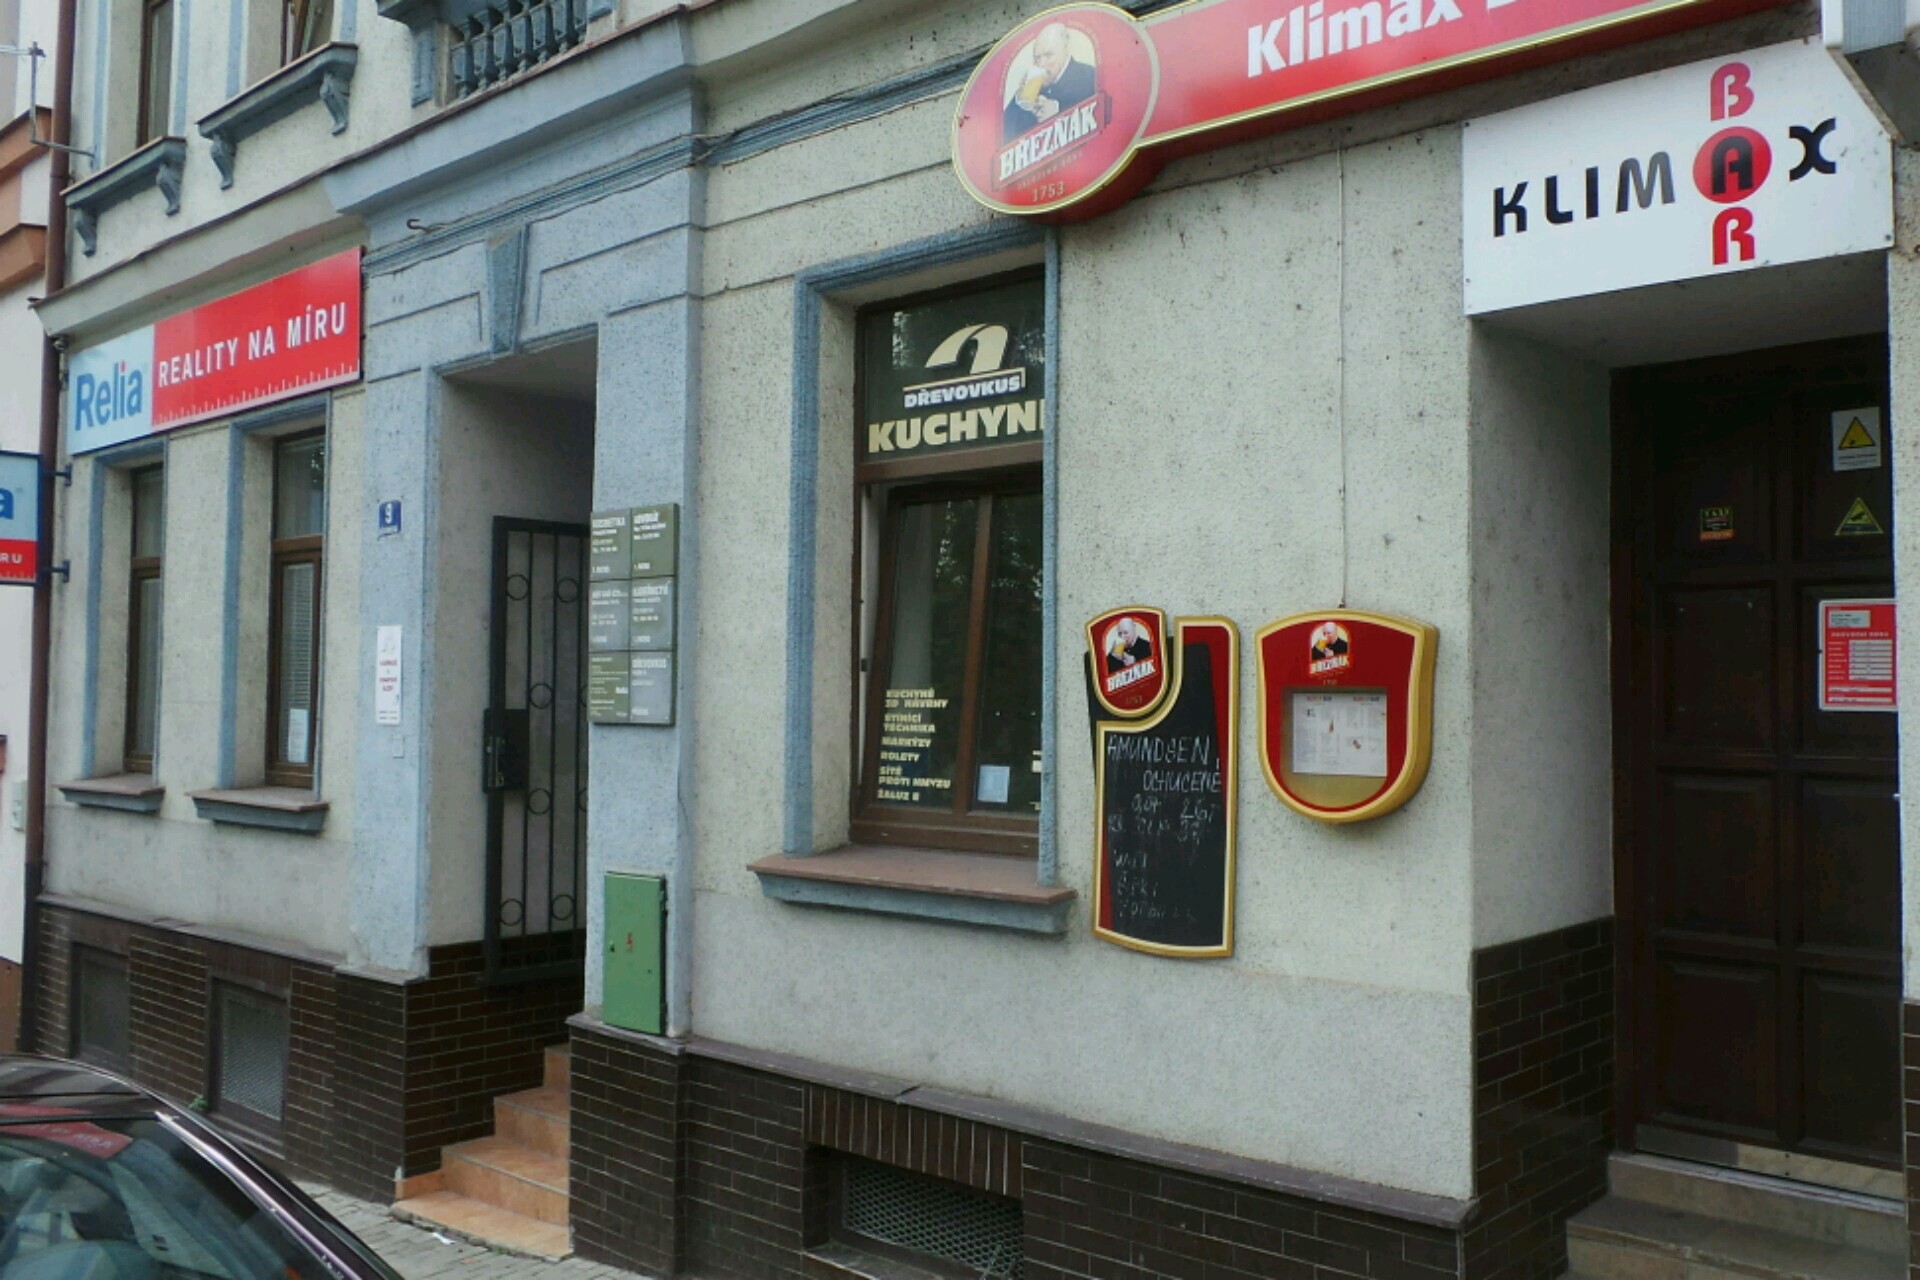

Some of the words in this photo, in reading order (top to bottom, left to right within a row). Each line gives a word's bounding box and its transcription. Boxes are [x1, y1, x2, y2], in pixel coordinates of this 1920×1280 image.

[1247, 0, 1463, 78] Klimax
[1032, 181, 1065, 202] 1753
[158, 338, 238, 388] REALITY
[248, 325, 276, 360] NA
[75, 360, 143, 431] Relia
[868, 399, 1045, 453] KUCHYN
[878, 776, 911, 787] PROTI
